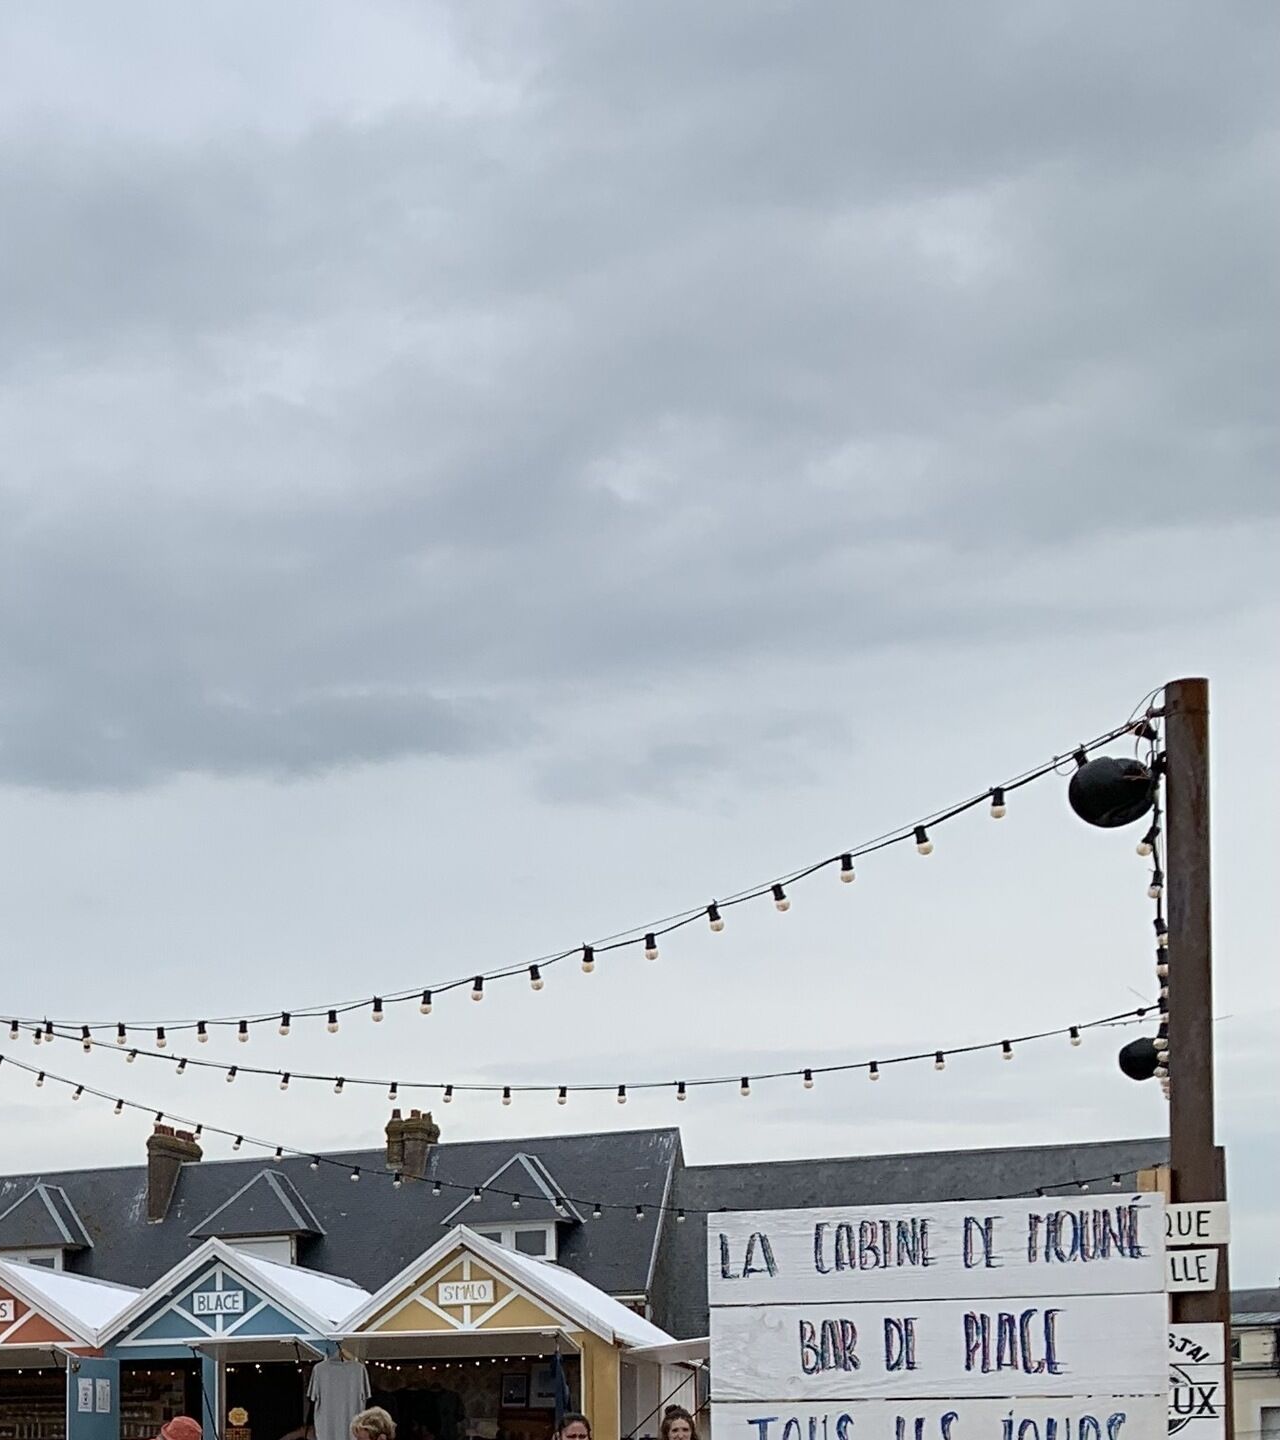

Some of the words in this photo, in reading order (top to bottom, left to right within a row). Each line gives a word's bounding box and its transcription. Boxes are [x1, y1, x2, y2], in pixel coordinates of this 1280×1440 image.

[718, 1232, 778, 1279] LA
[814, 1216, 937, 1274] CABINE
[963, 1215, 1004, 1268] DE
[799, 1318, 861, 1375] BAR
[884, 1316, 920, 1371] DE
